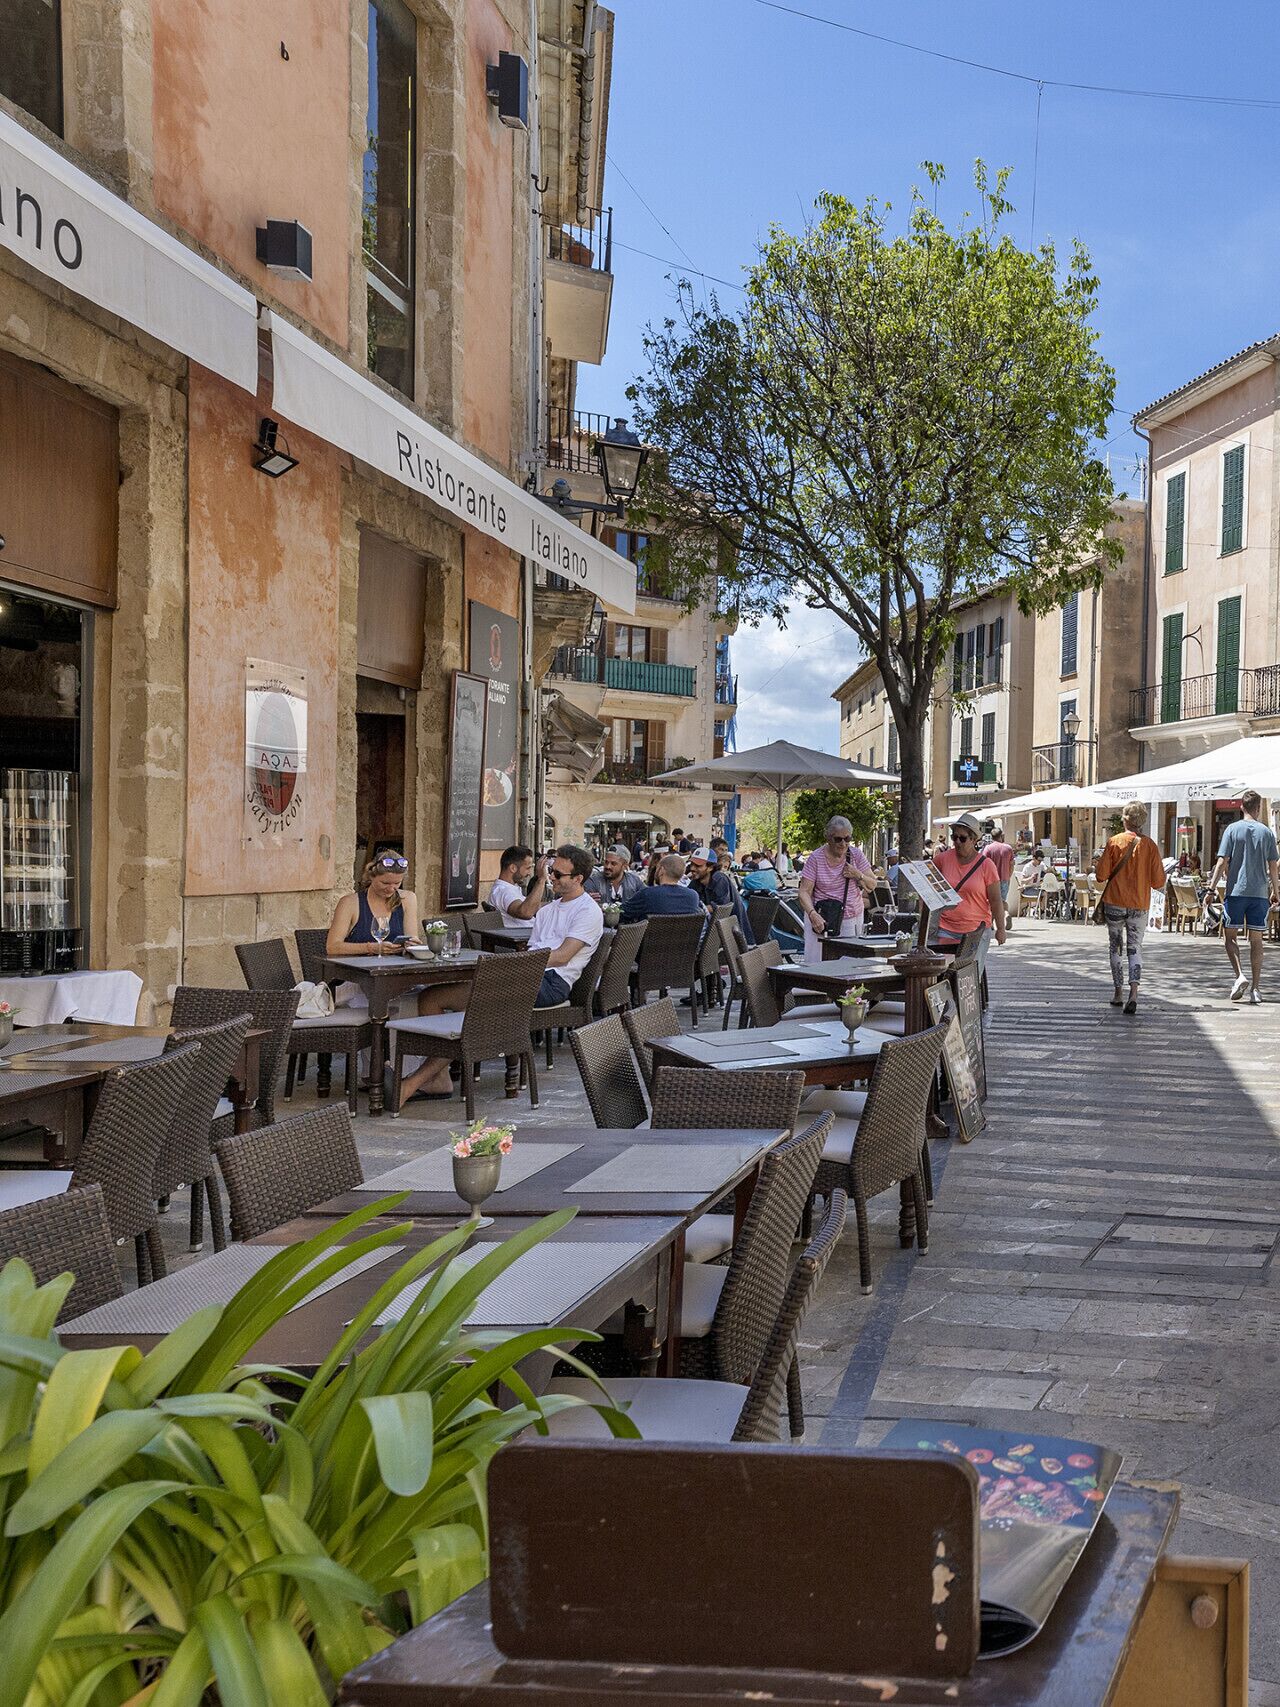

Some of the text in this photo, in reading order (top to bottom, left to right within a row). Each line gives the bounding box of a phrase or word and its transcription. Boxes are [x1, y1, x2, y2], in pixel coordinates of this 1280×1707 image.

[0, 184, 82, 270] no
[397, 430, 588, 579] Ristorante Italiano
[247, 791, 302, 833] Satyricon
